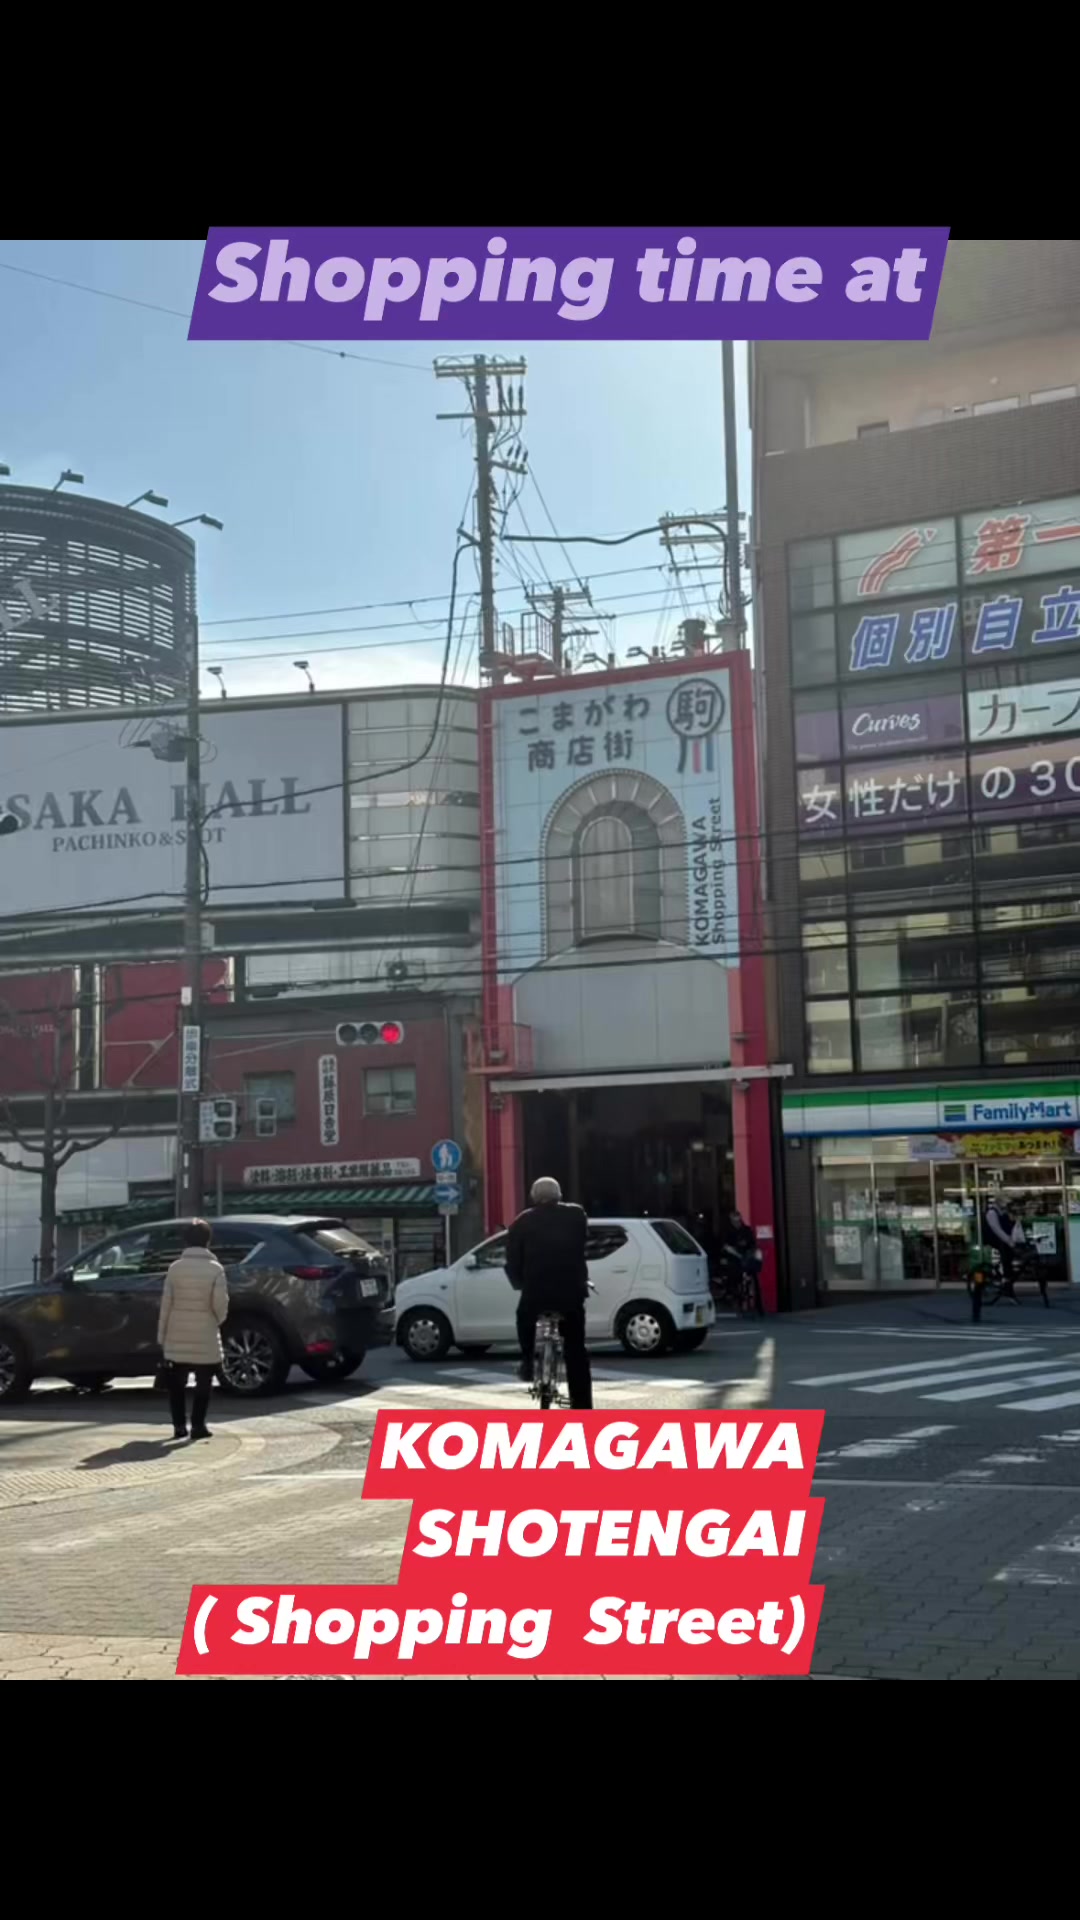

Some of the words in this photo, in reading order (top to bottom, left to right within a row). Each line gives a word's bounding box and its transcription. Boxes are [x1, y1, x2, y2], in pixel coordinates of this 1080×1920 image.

[849, 585, 1080, 671] 個別自立
[519, 693, 650, 736] こまがわ
[851, 711, 921, 737] Curves
[527, 731, 634, 773] 商店街
[0, 786, 141, 832] SAKA
[170, 776, 311, 822] HALL
[708, 796, 723, 852] Street
[52, 826, 226, 852] PACHINKO&SOT
[691, 815, 711, 947] KOMAGAWA
[710, 858, 727, 945] Shopping
[972, 1100, 1072, 1122] FamilyMart
